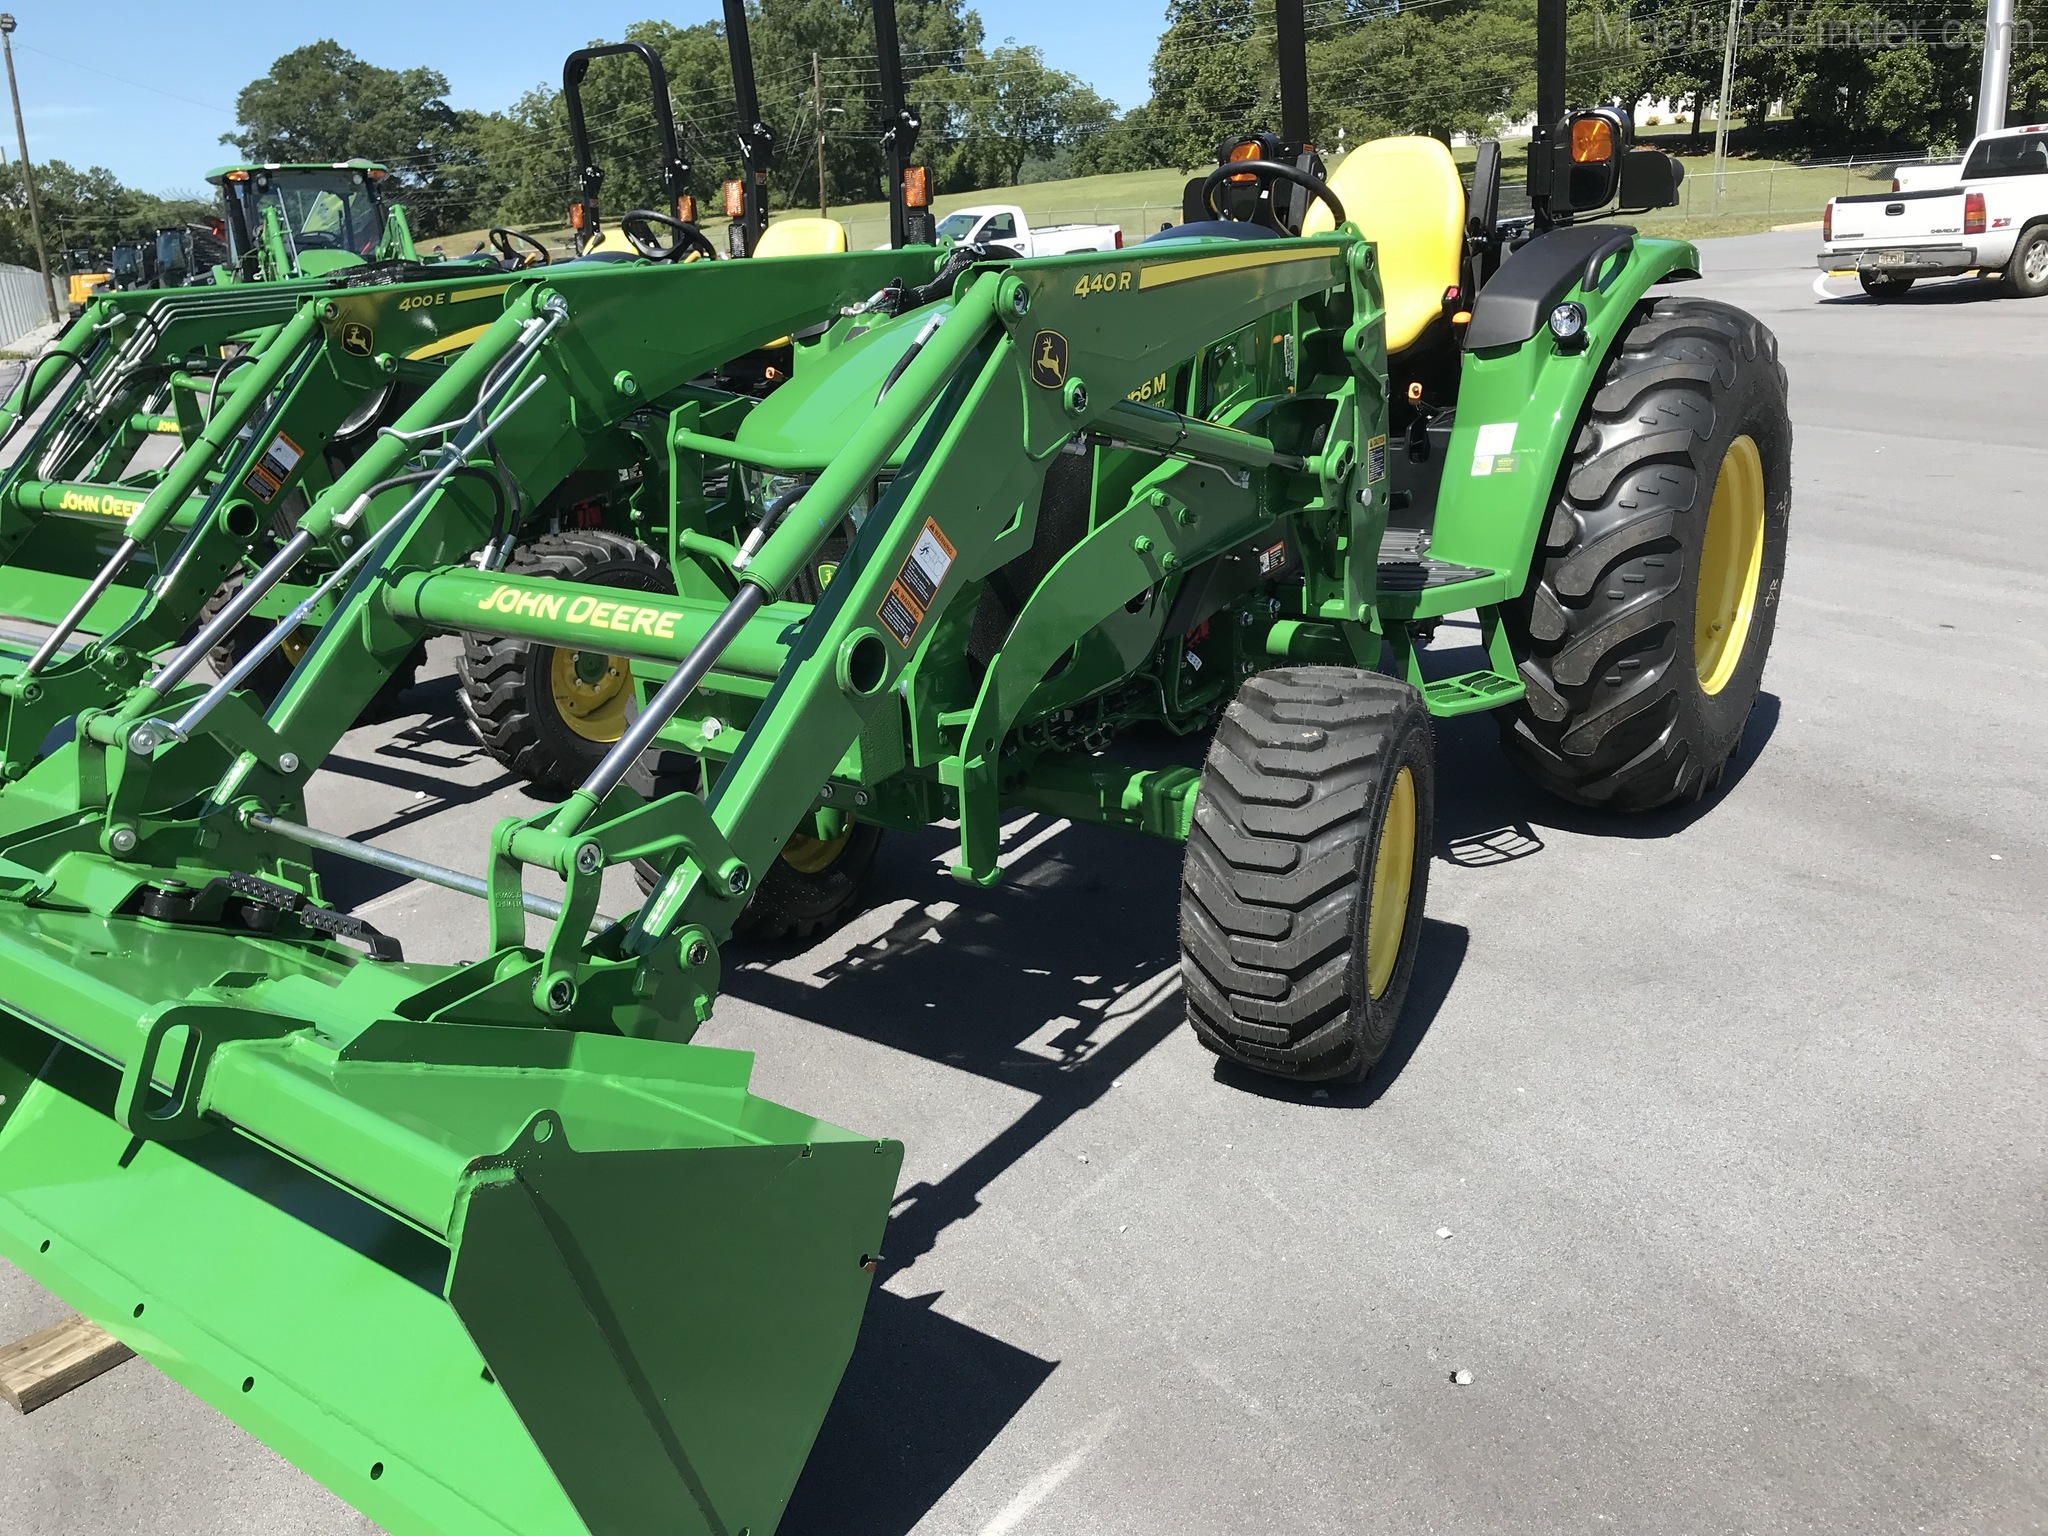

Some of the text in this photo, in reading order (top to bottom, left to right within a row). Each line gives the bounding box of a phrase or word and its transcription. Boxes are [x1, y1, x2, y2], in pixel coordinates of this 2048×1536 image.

[1073, 270, 1132, 299] 440 R
[399, 292, 445, 311] 400 E
[1127, 372, 1166, 402] 66 M
[60, 490, 140, 517] JOHN DEE
[478, 585, 684, 638] JOHN DEERE
